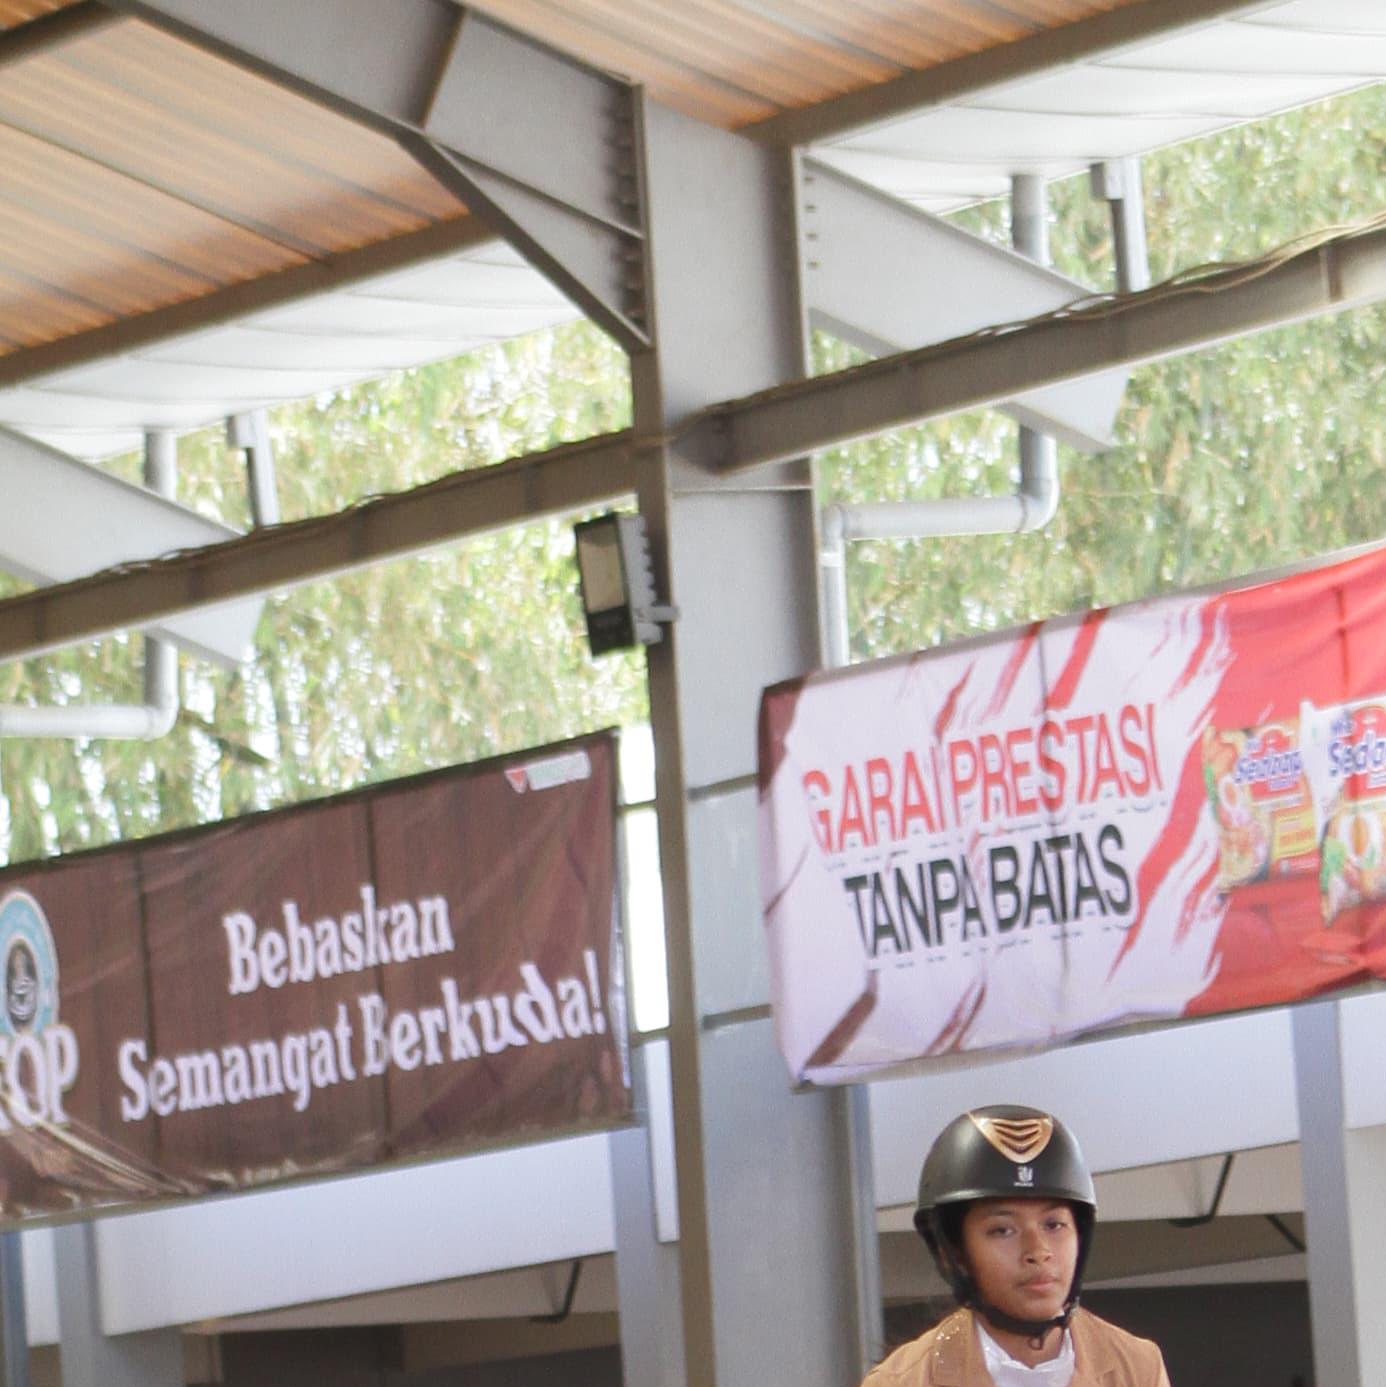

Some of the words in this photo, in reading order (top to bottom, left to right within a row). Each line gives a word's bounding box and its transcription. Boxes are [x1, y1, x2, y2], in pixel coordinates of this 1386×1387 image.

[948, 703, 1164, 828] PRESTASI
[223, 884, 455, 995] Bebaskan
[843, 854, 987, 960] TANPA
[988, 824, 1131, 934] BATAS
[118, 1002, 356, 1122] Semangat
[358, 949, 606, 1078] Berkuda!
